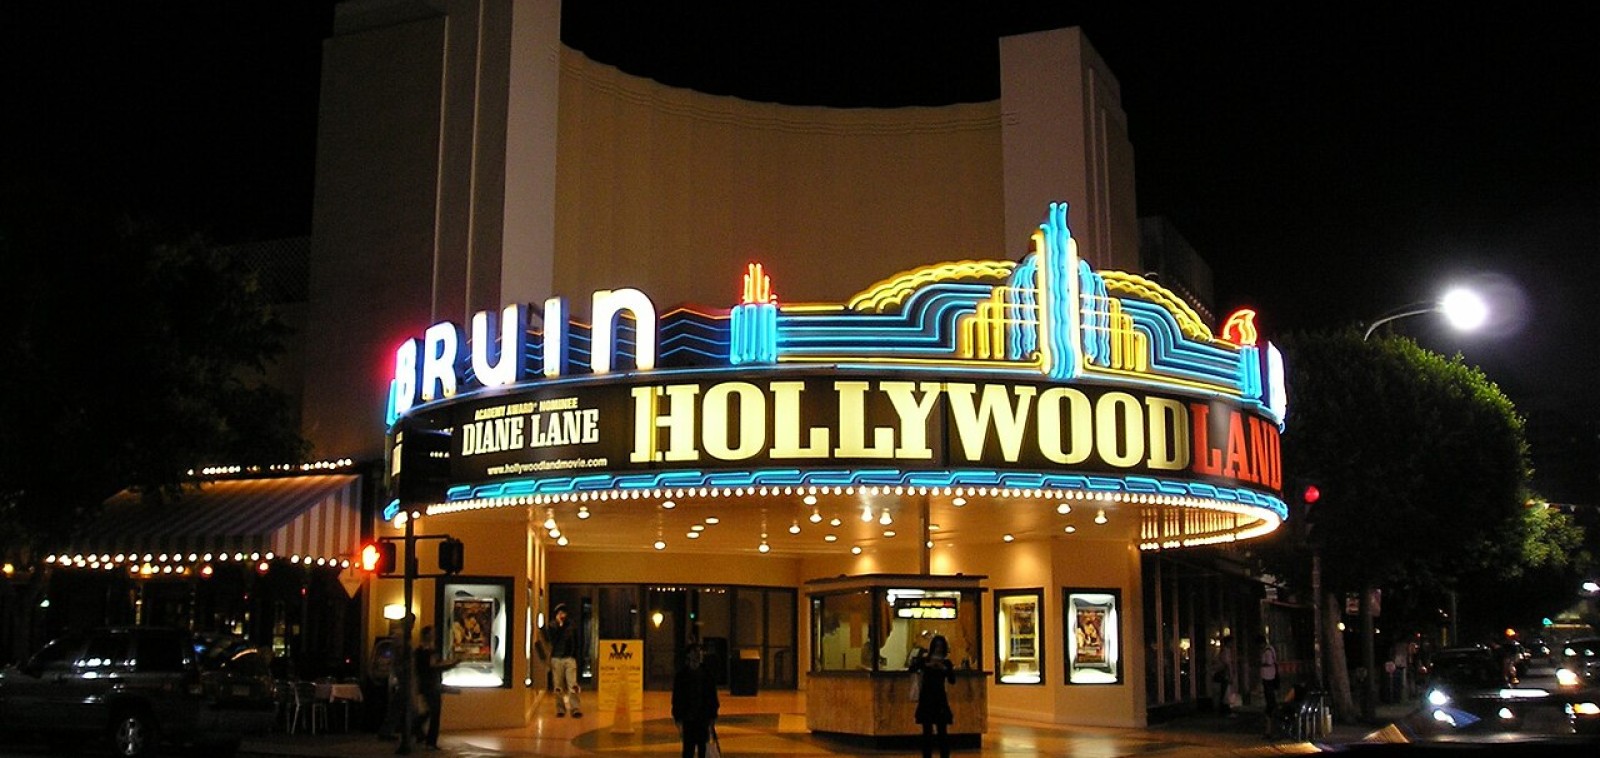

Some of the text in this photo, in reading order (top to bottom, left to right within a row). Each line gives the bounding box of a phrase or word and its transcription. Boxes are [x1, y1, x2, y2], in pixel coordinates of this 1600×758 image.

[474, 406, 506, 421] ACADEMY
[539, 397, 579, 412] NOMINEE
[461, 408, 600, 456] DIANE LANE
[487, 458, 608, 475] www.hollywoodlandmovie.com
